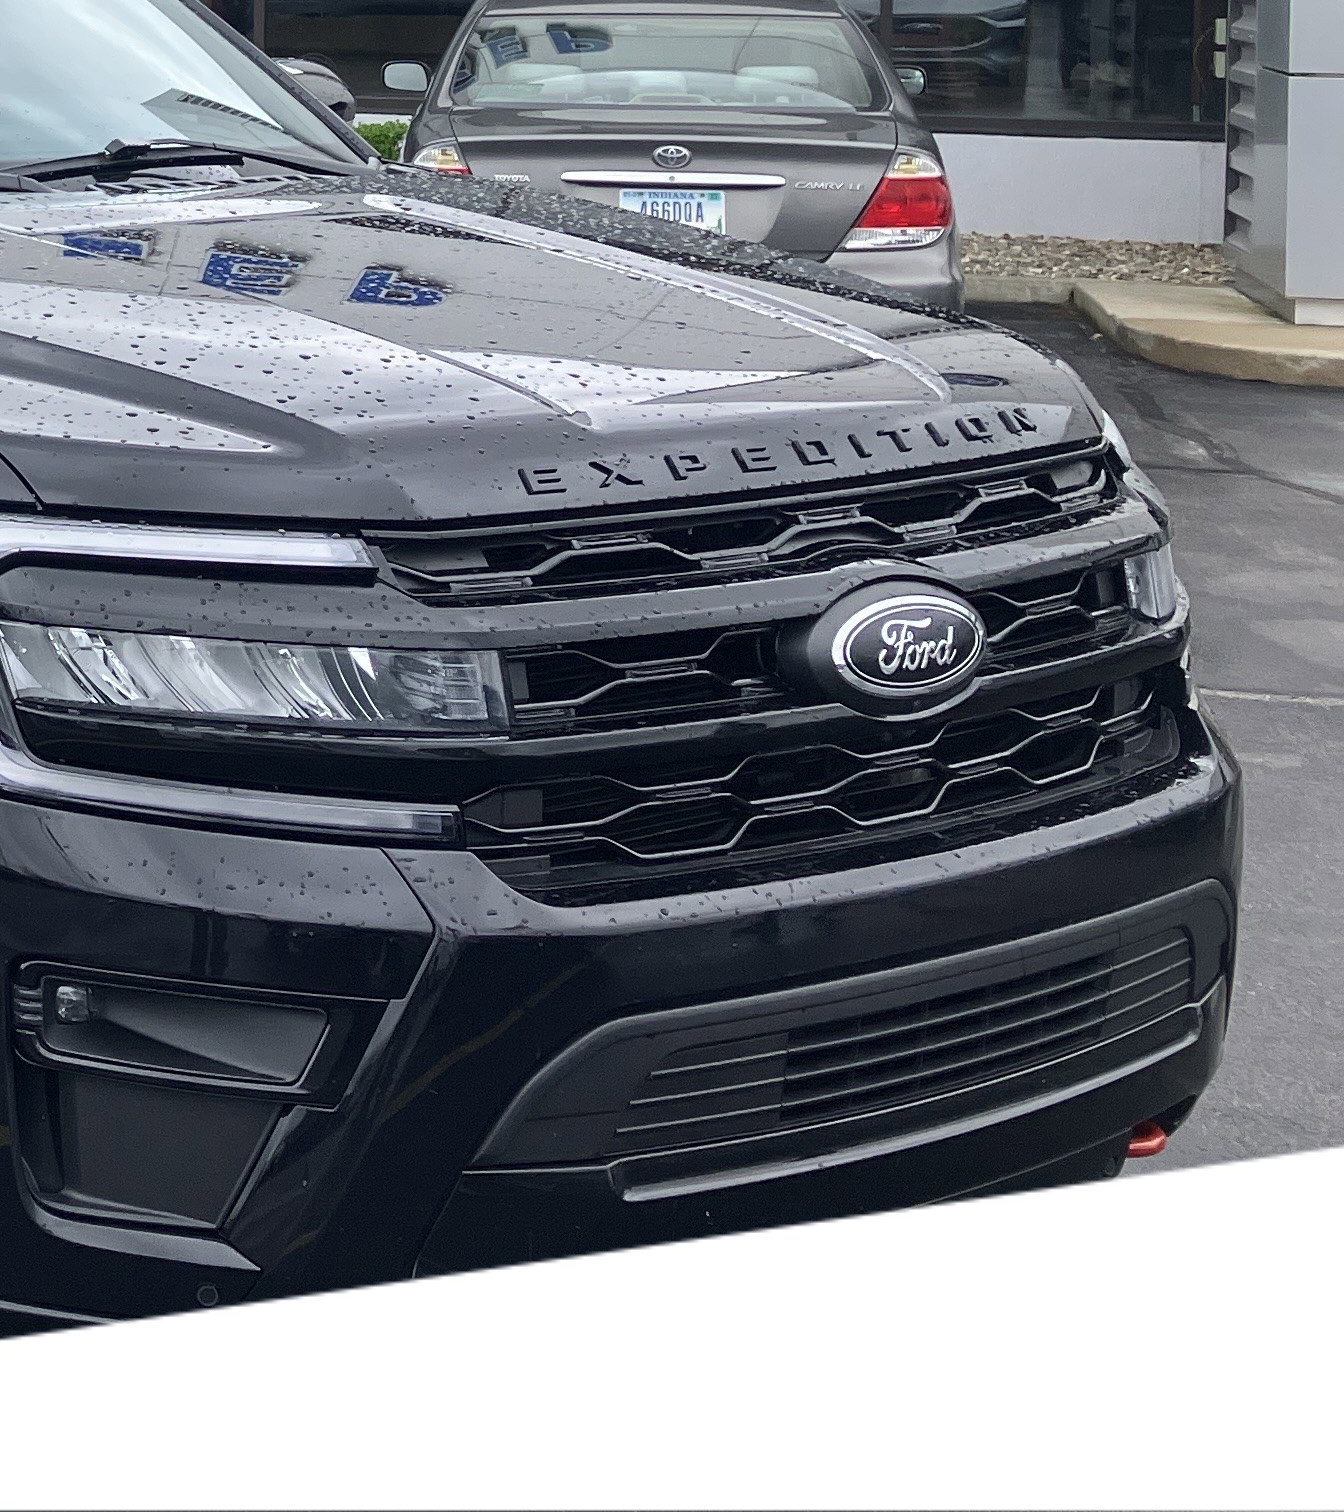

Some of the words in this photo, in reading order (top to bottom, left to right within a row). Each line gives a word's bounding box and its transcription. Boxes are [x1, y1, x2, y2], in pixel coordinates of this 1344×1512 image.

[493, 173, 531, 183] TOYOTA
[794, 180, 844, 190] CAMRY
[647, 191, 695, 200] INDIANA
[517, 406, 1038, 496] EXPEDITION
[877, 617, 958, 677] Ford
